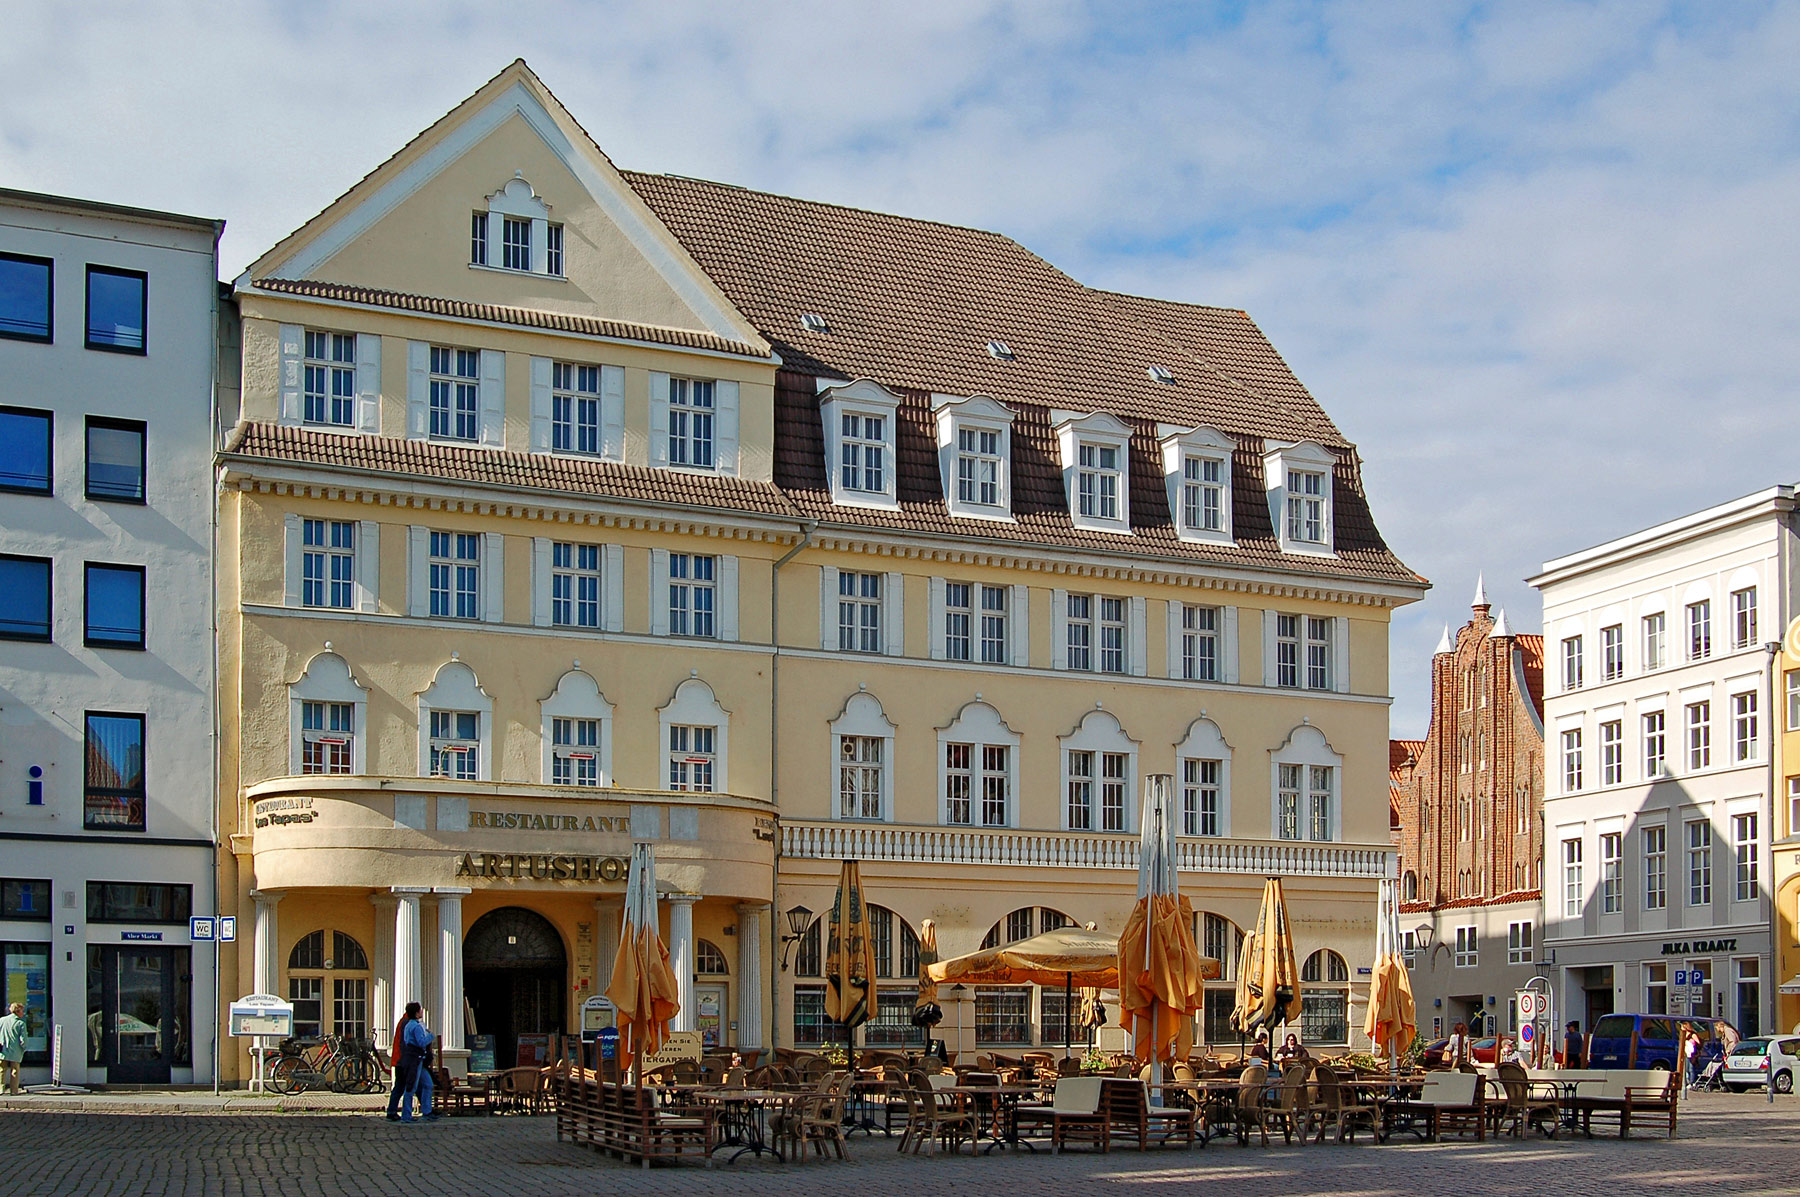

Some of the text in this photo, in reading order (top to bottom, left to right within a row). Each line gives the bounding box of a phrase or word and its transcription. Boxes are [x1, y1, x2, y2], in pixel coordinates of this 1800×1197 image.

[468, 810, 630, 834] RESTAURANT
[456, 852, 633, 882] ARTUSHO
[196, 925, 209, 933] WC
[1660, 938, 1738, 955] JILKA KRAATZ
[1677, 972, 1684, 983] P
[1693, 971, 1701, 983] P
